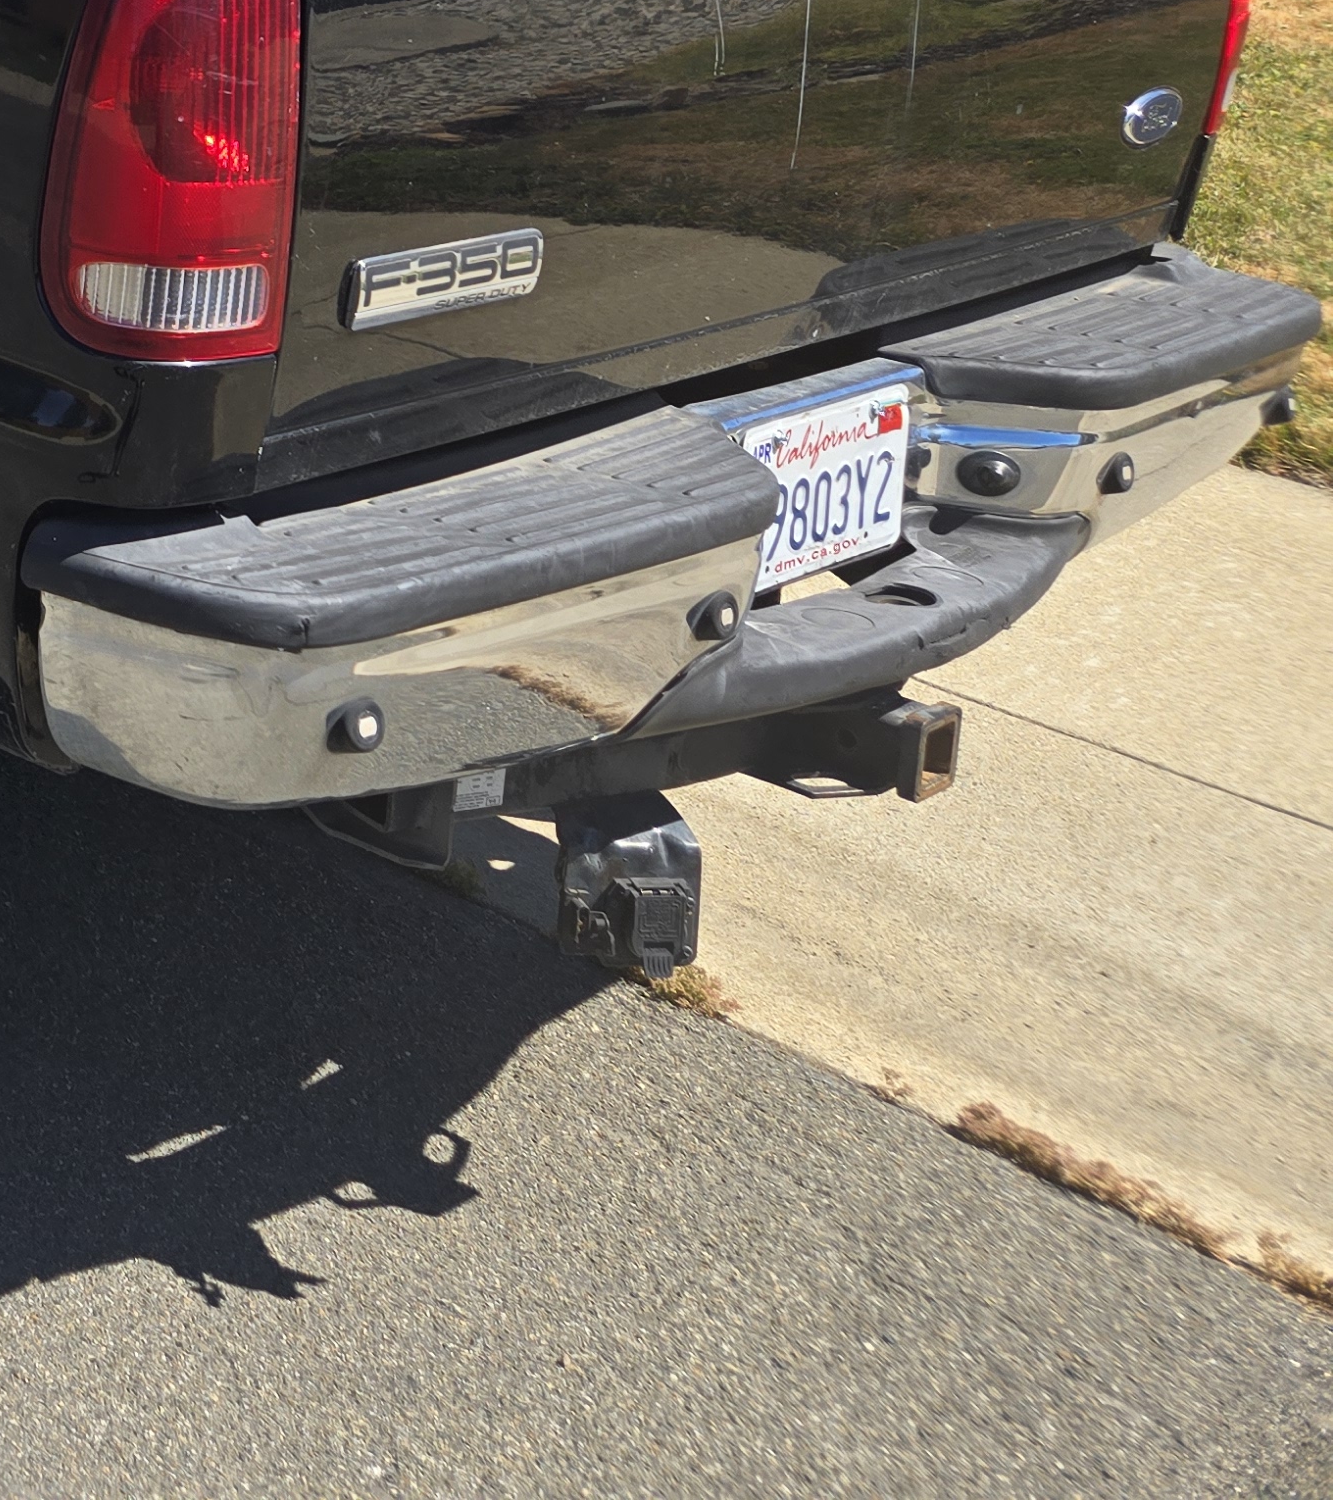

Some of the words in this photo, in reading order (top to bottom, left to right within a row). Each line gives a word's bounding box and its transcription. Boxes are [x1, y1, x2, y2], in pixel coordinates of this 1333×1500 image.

[434, 291, 486, 311] SUPER
[487, 282, 532, 299] DUTY
[775, 420, 879, 470] California
[761, 450, 895, 562] 9803Y2
[774, 536, 860, 574] dmv.ca.gov
